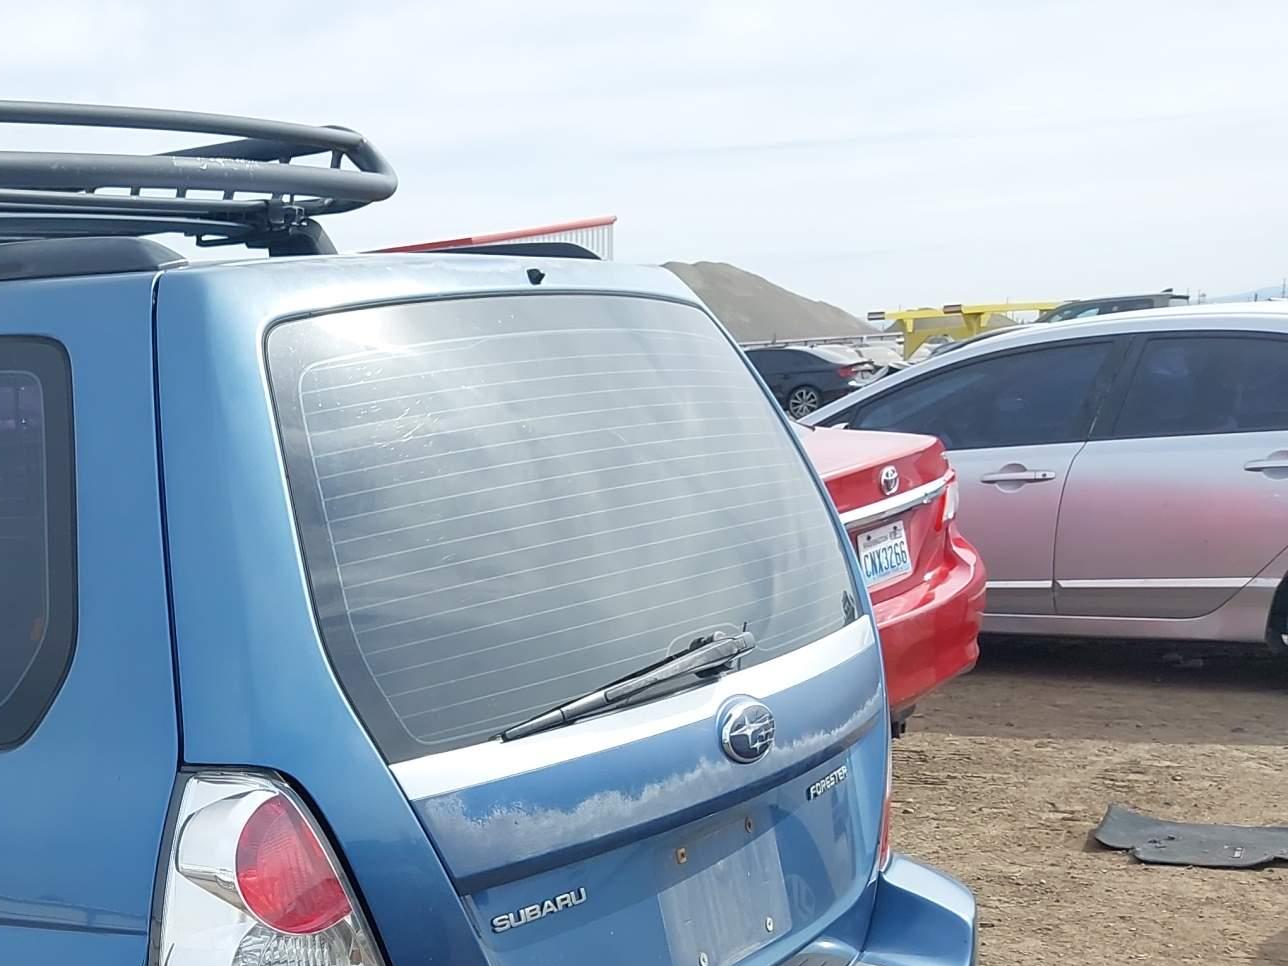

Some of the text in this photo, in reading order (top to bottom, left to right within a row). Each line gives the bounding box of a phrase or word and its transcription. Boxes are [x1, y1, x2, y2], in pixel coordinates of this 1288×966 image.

[863, 540, 908, 578] CNX3266
[810, 765, 848, 800] FORESTER
[492, 887, 587, 932] SUBARU
